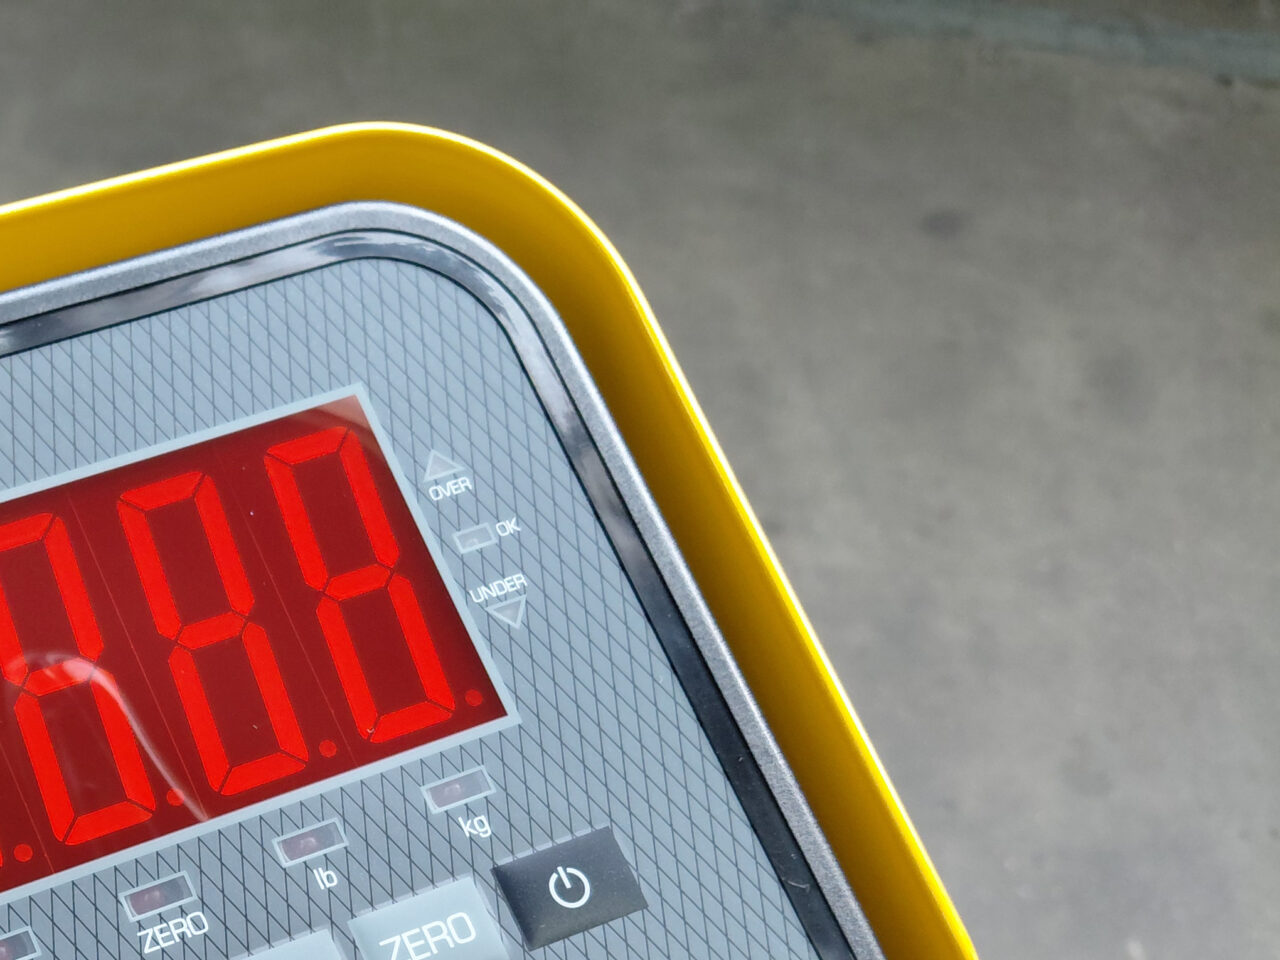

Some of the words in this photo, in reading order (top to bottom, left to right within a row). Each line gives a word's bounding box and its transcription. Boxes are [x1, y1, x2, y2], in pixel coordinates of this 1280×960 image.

[428, 475, 472, 501] OVER
[495, 516, 521, 538] OK
[469, 572, 528, 604] UNDER
[458, 813, 493, 839] kg
[313, 866, 338, 891] lb
[137, 910, 210, 954] ZERO
